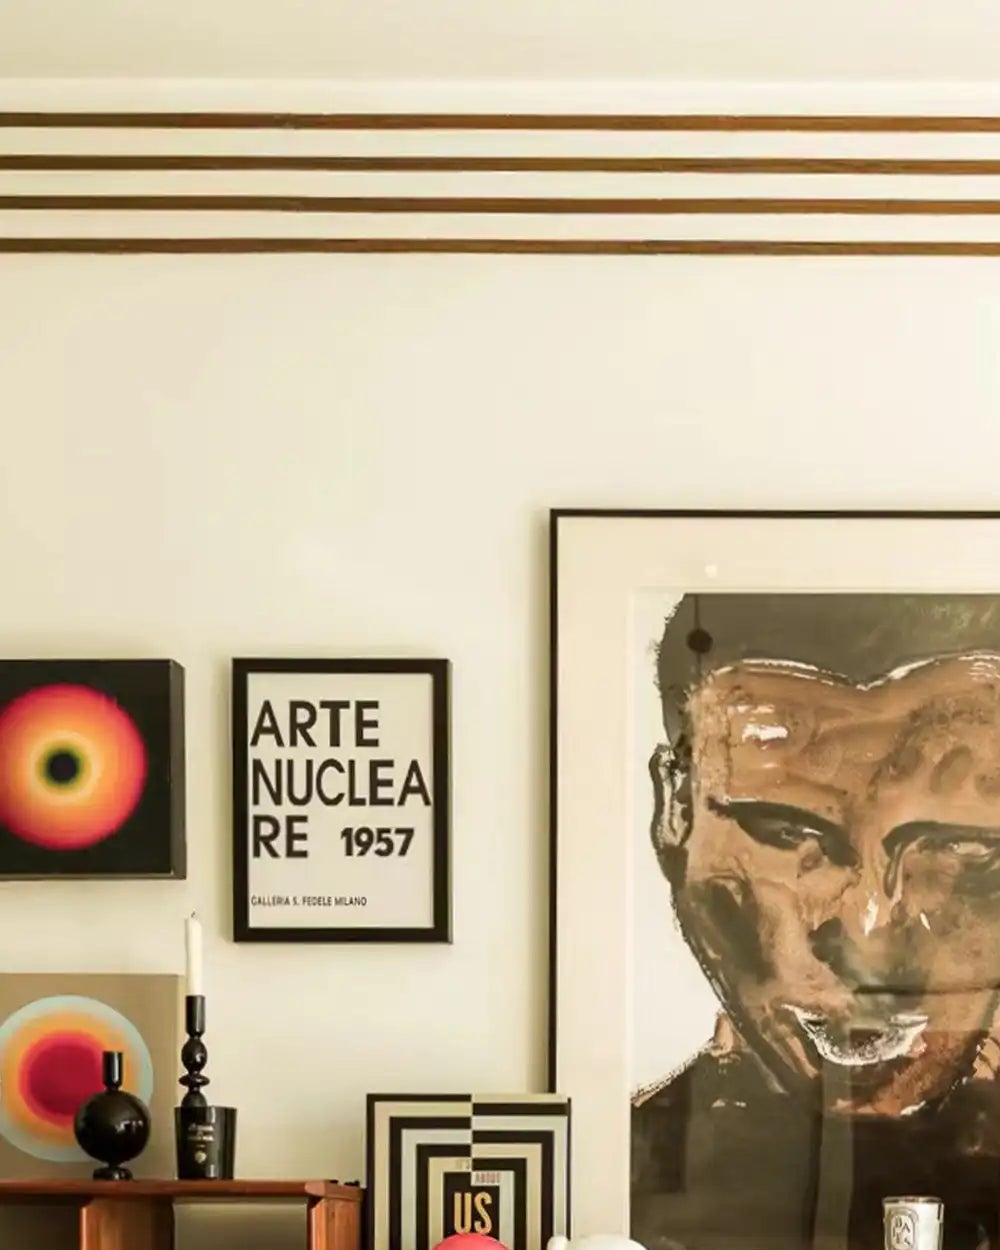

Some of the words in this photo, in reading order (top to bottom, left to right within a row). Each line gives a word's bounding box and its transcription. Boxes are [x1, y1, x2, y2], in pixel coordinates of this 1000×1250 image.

[250, 699, 380, 747] ARTE
[252, 758, 432, 806] NUCLEA
[252, 814, 309, 858] RE
[340, 827, 415, 857] 1957
[251, 895, 291, 907] GALLERIA
[302, 896, 332, 906] FEDELE
[334, 896, 368, 907] MILANO
[453, 1191, 493, 1235] US
